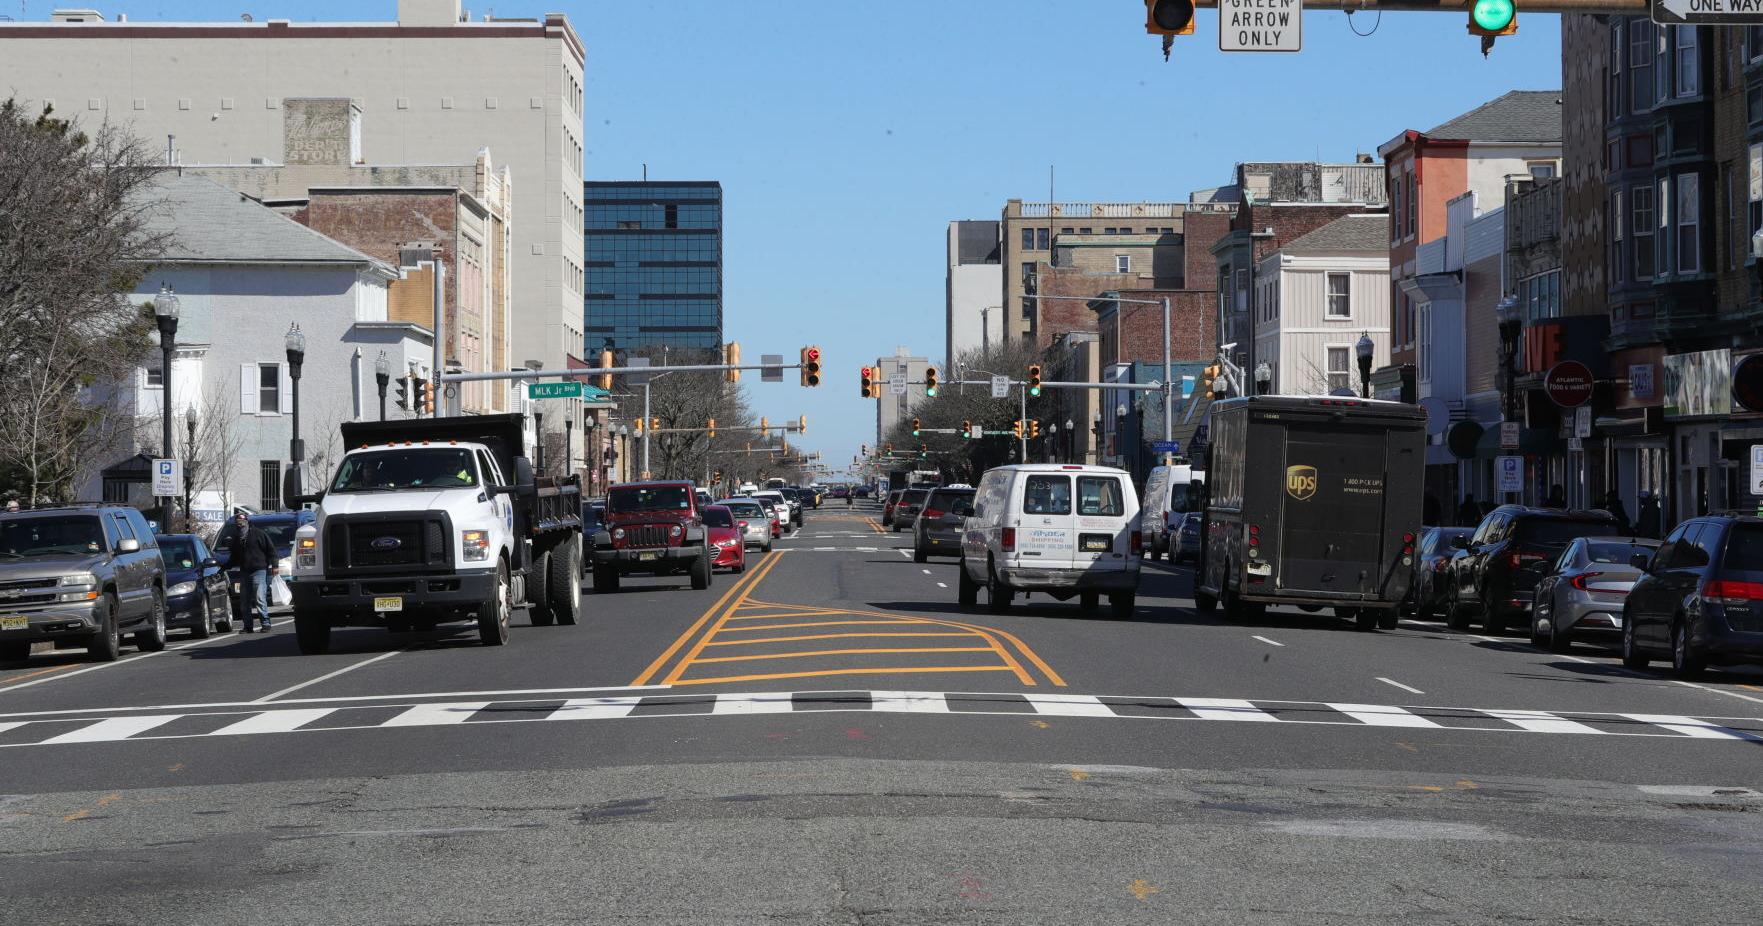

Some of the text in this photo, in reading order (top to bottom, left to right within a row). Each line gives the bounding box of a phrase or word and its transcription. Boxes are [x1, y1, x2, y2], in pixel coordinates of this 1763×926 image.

[1690, 0, 1763, 11] ONE WAY
[1231, 12, 1290, 27] ARROW
[1239, 31, 1282, 46] ONLY
[535, 387, 551, 397] MLK
[553, 386, 562, 395] Jr
[1288, 475, 1315, 495] ups
[203, 511, 222, 521] SALE
